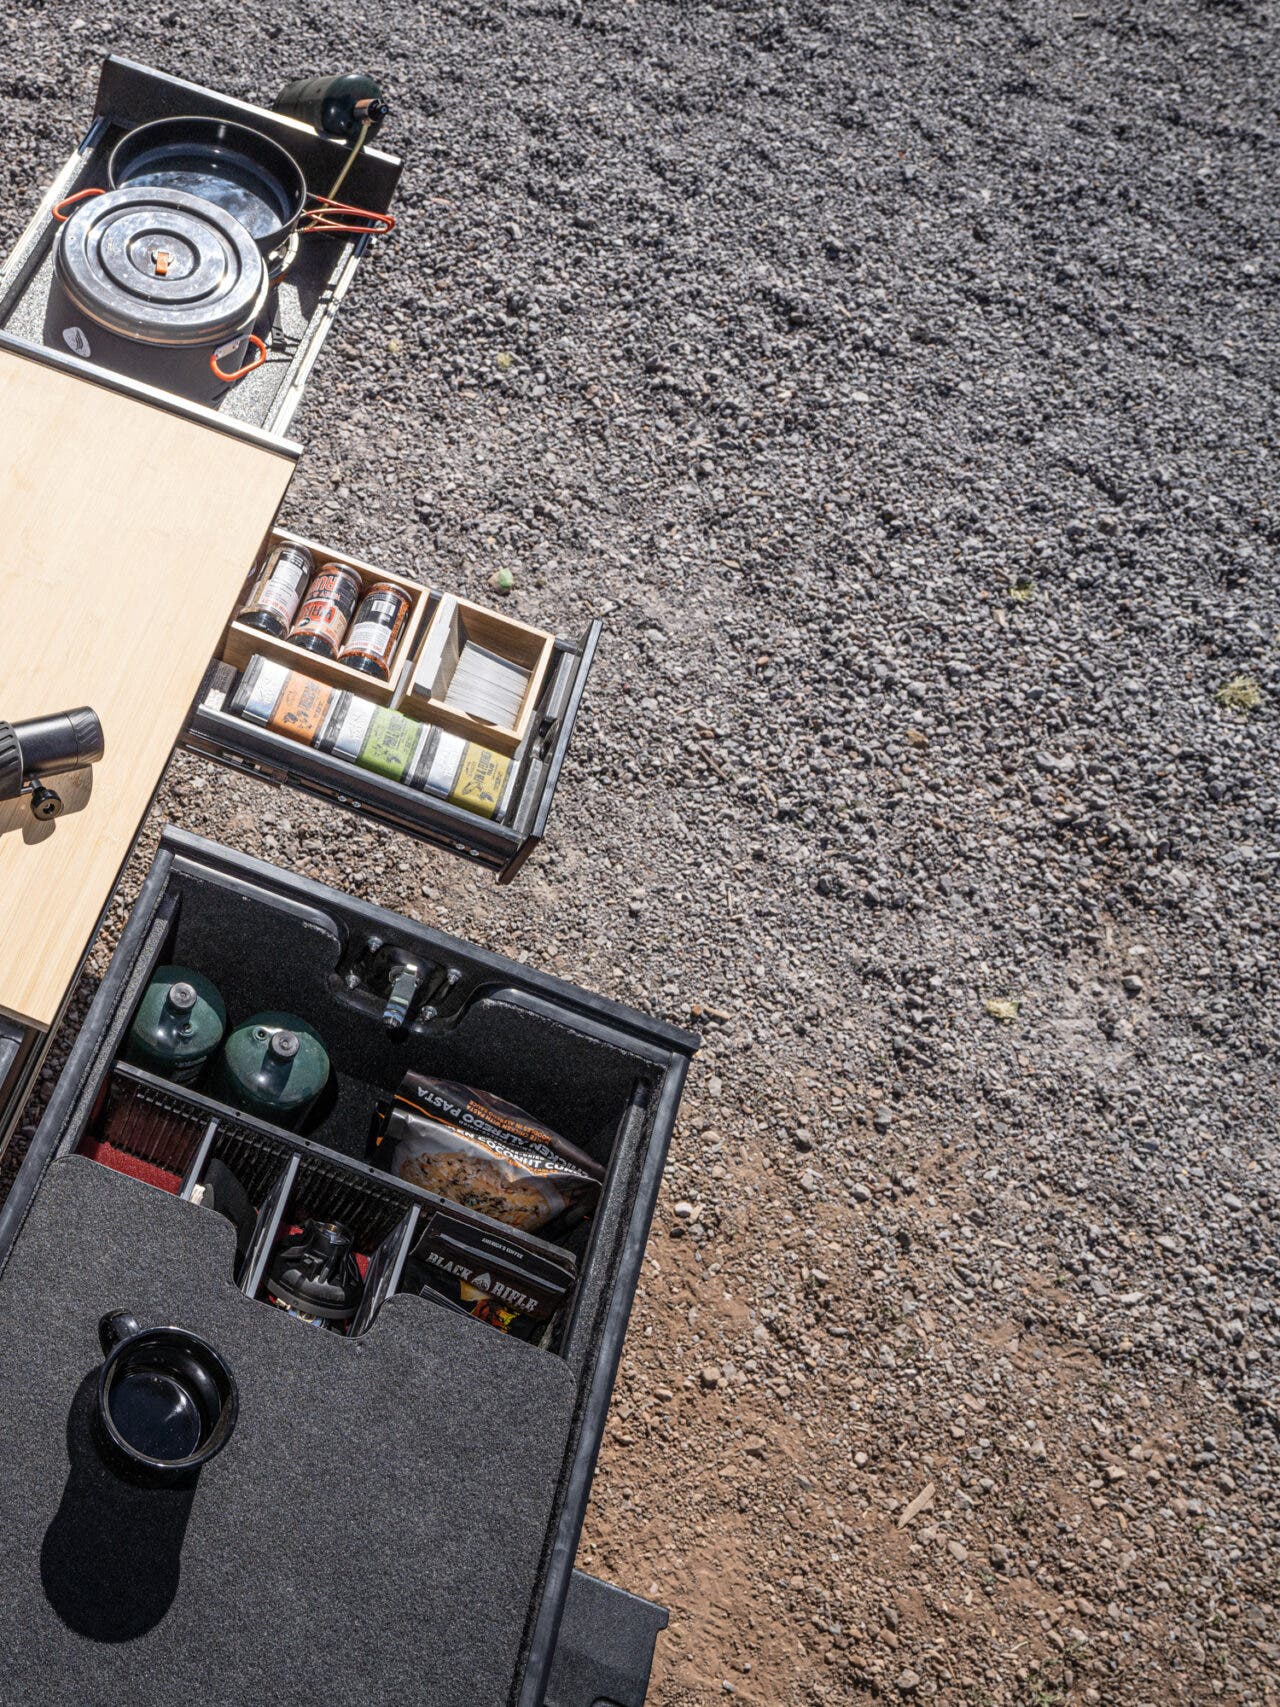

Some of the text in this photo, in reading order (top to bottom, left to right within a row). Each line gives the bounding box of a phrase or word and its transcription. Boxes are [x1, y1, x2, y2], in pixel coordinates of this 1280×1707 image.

[418, 1087, 461, 1117] PASTA
[466, 1104, 484, 1118] PASTA
[464, 1114, 528, 1145] ALFREDO
[425, 1251, 539, 1313] BLACK RIFLE
